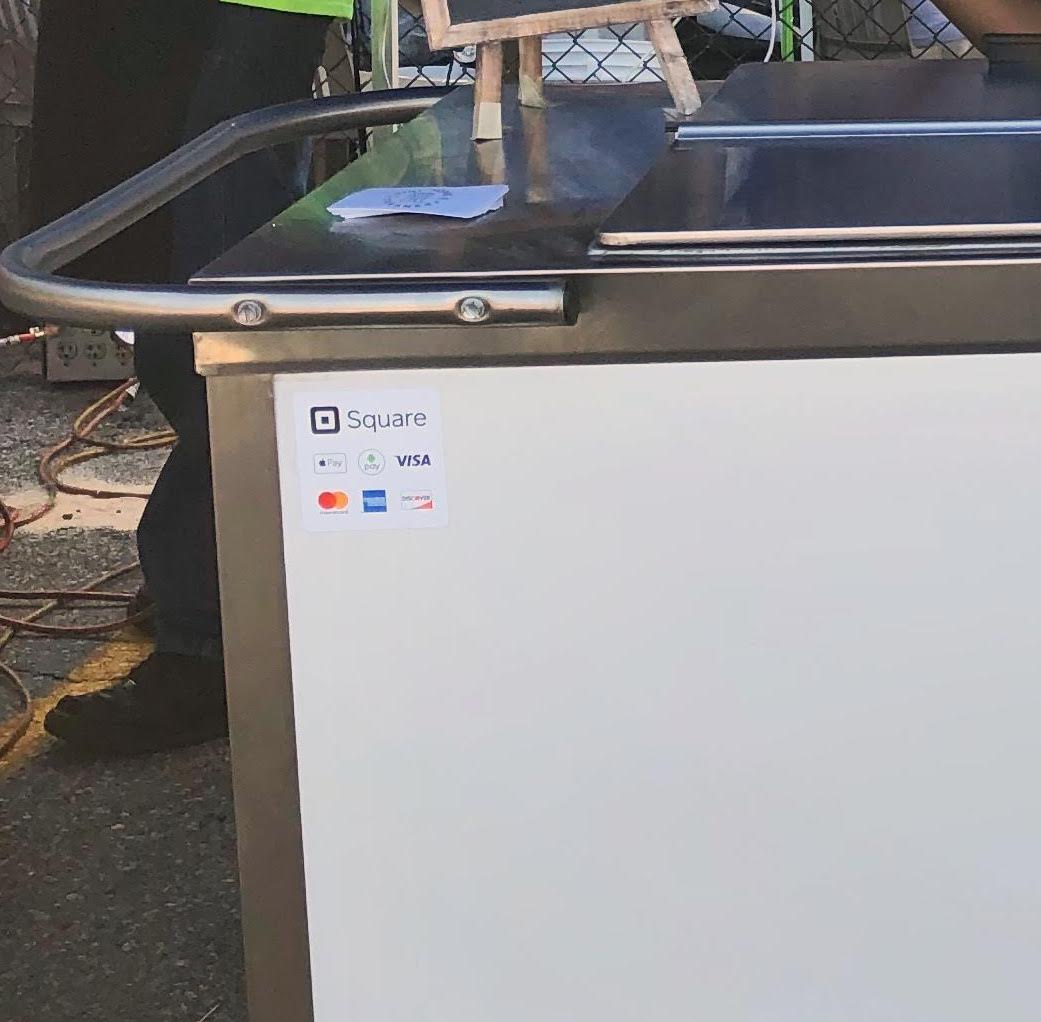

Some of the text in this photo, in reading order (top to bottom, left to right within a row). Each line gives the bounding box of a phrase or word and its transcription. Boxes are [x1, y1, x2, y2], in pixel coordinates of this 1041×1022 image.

[348, 411, 427, 432] Square
[396, 455, 431, 466] VISA
[364, 463, 381, 472] pay
